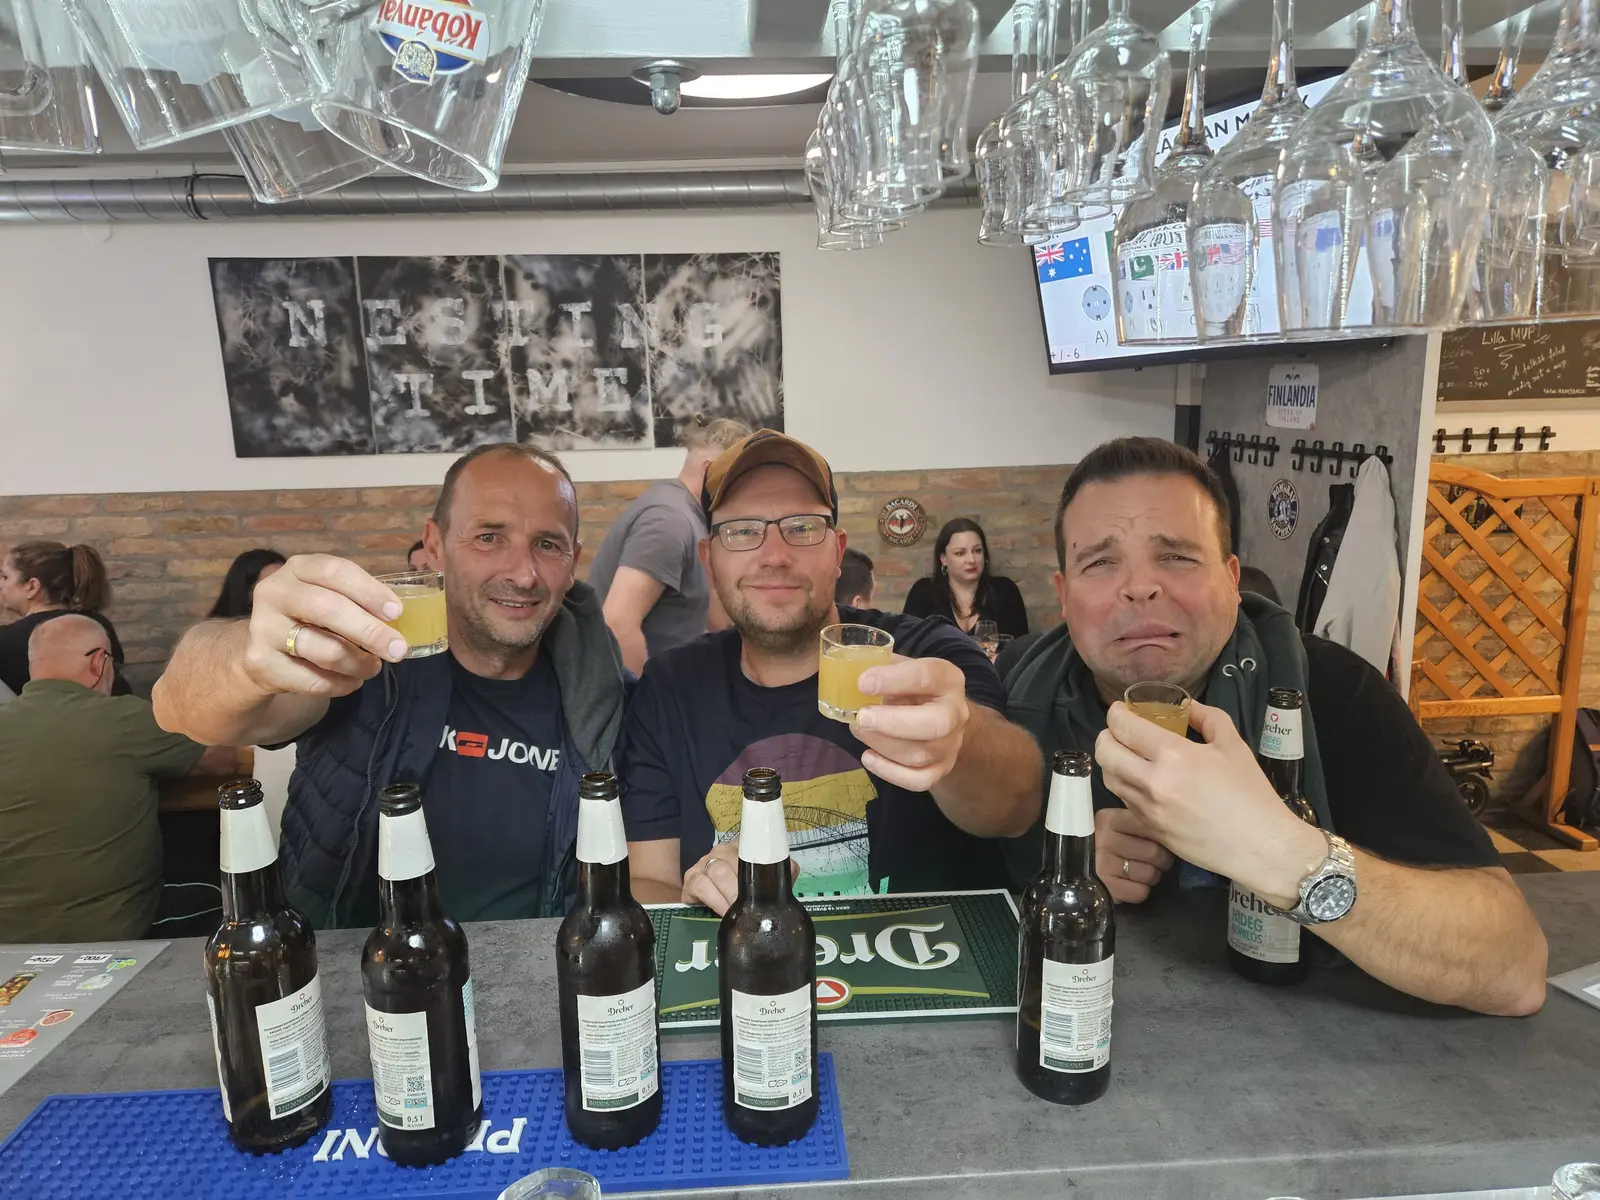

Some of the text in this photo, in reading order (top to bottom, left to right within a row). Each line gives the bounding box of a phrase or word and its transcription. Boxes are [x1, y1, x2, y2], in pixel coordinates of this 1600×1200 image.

[282, 298, 724, 348] NESTING
[1095, 330, 1109, 346] A)
[1481, 326, 1536, 346] Lilla MVP
[394, 367, 631, 418] TIME
[1268, 385, 1316, 408] FINLANDIA
[885, 499, 917, 511] BACARDI
[1232, 908, 1263, 932] HIDEG
[1072, 975, 1097, 984] Dreher
[291, 995, 313, 1014] Dreher
[607, 1003, 634, 1016] Dreher
[759, 1006, 787, 1016] Dreher
[373, 1020, 394, 1033] Dreher
[407, 1115, 418, 1123] 0,5
